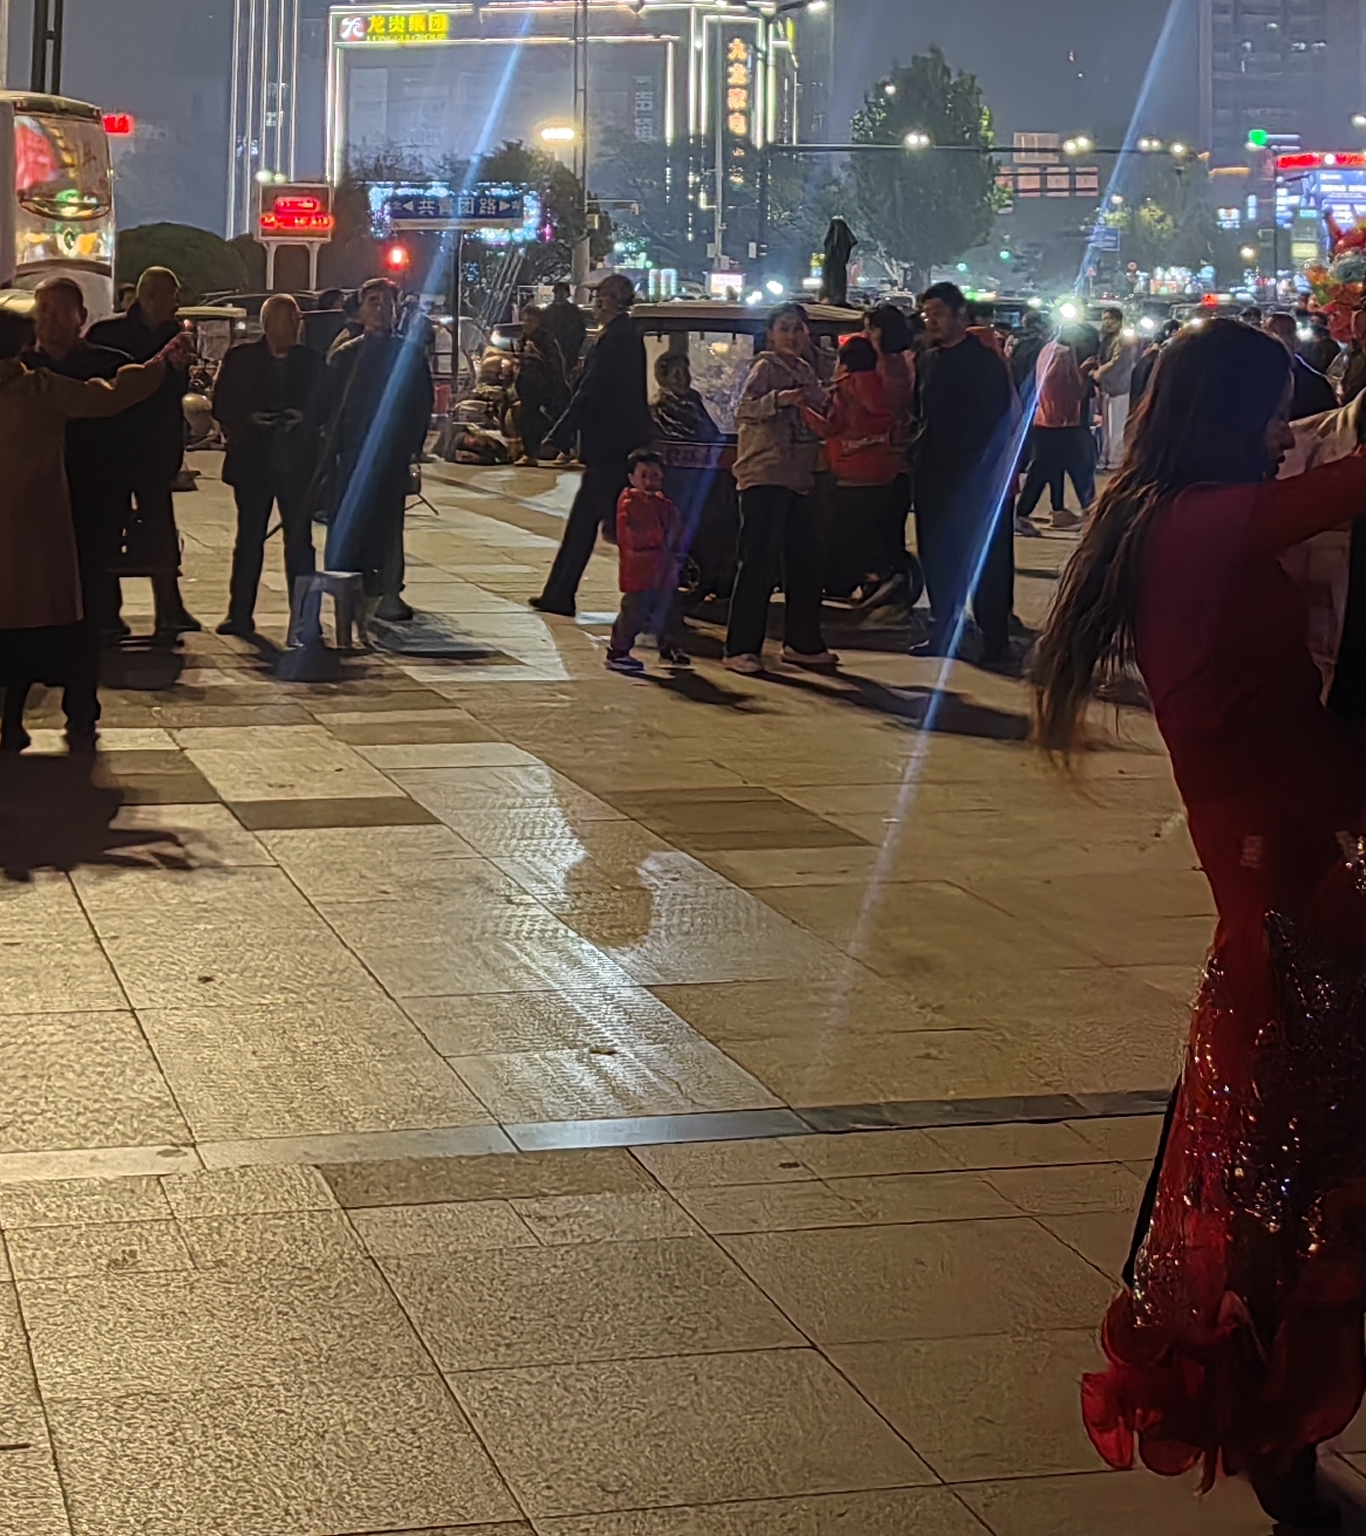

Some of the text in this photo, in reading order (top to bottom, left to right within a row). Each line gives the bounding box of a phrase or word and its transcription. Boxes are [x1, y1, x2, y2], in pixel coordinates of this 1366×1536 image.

[366, 14, 449, 33] 龙贵集团
[417, 197, 496, 216] 共青团路
